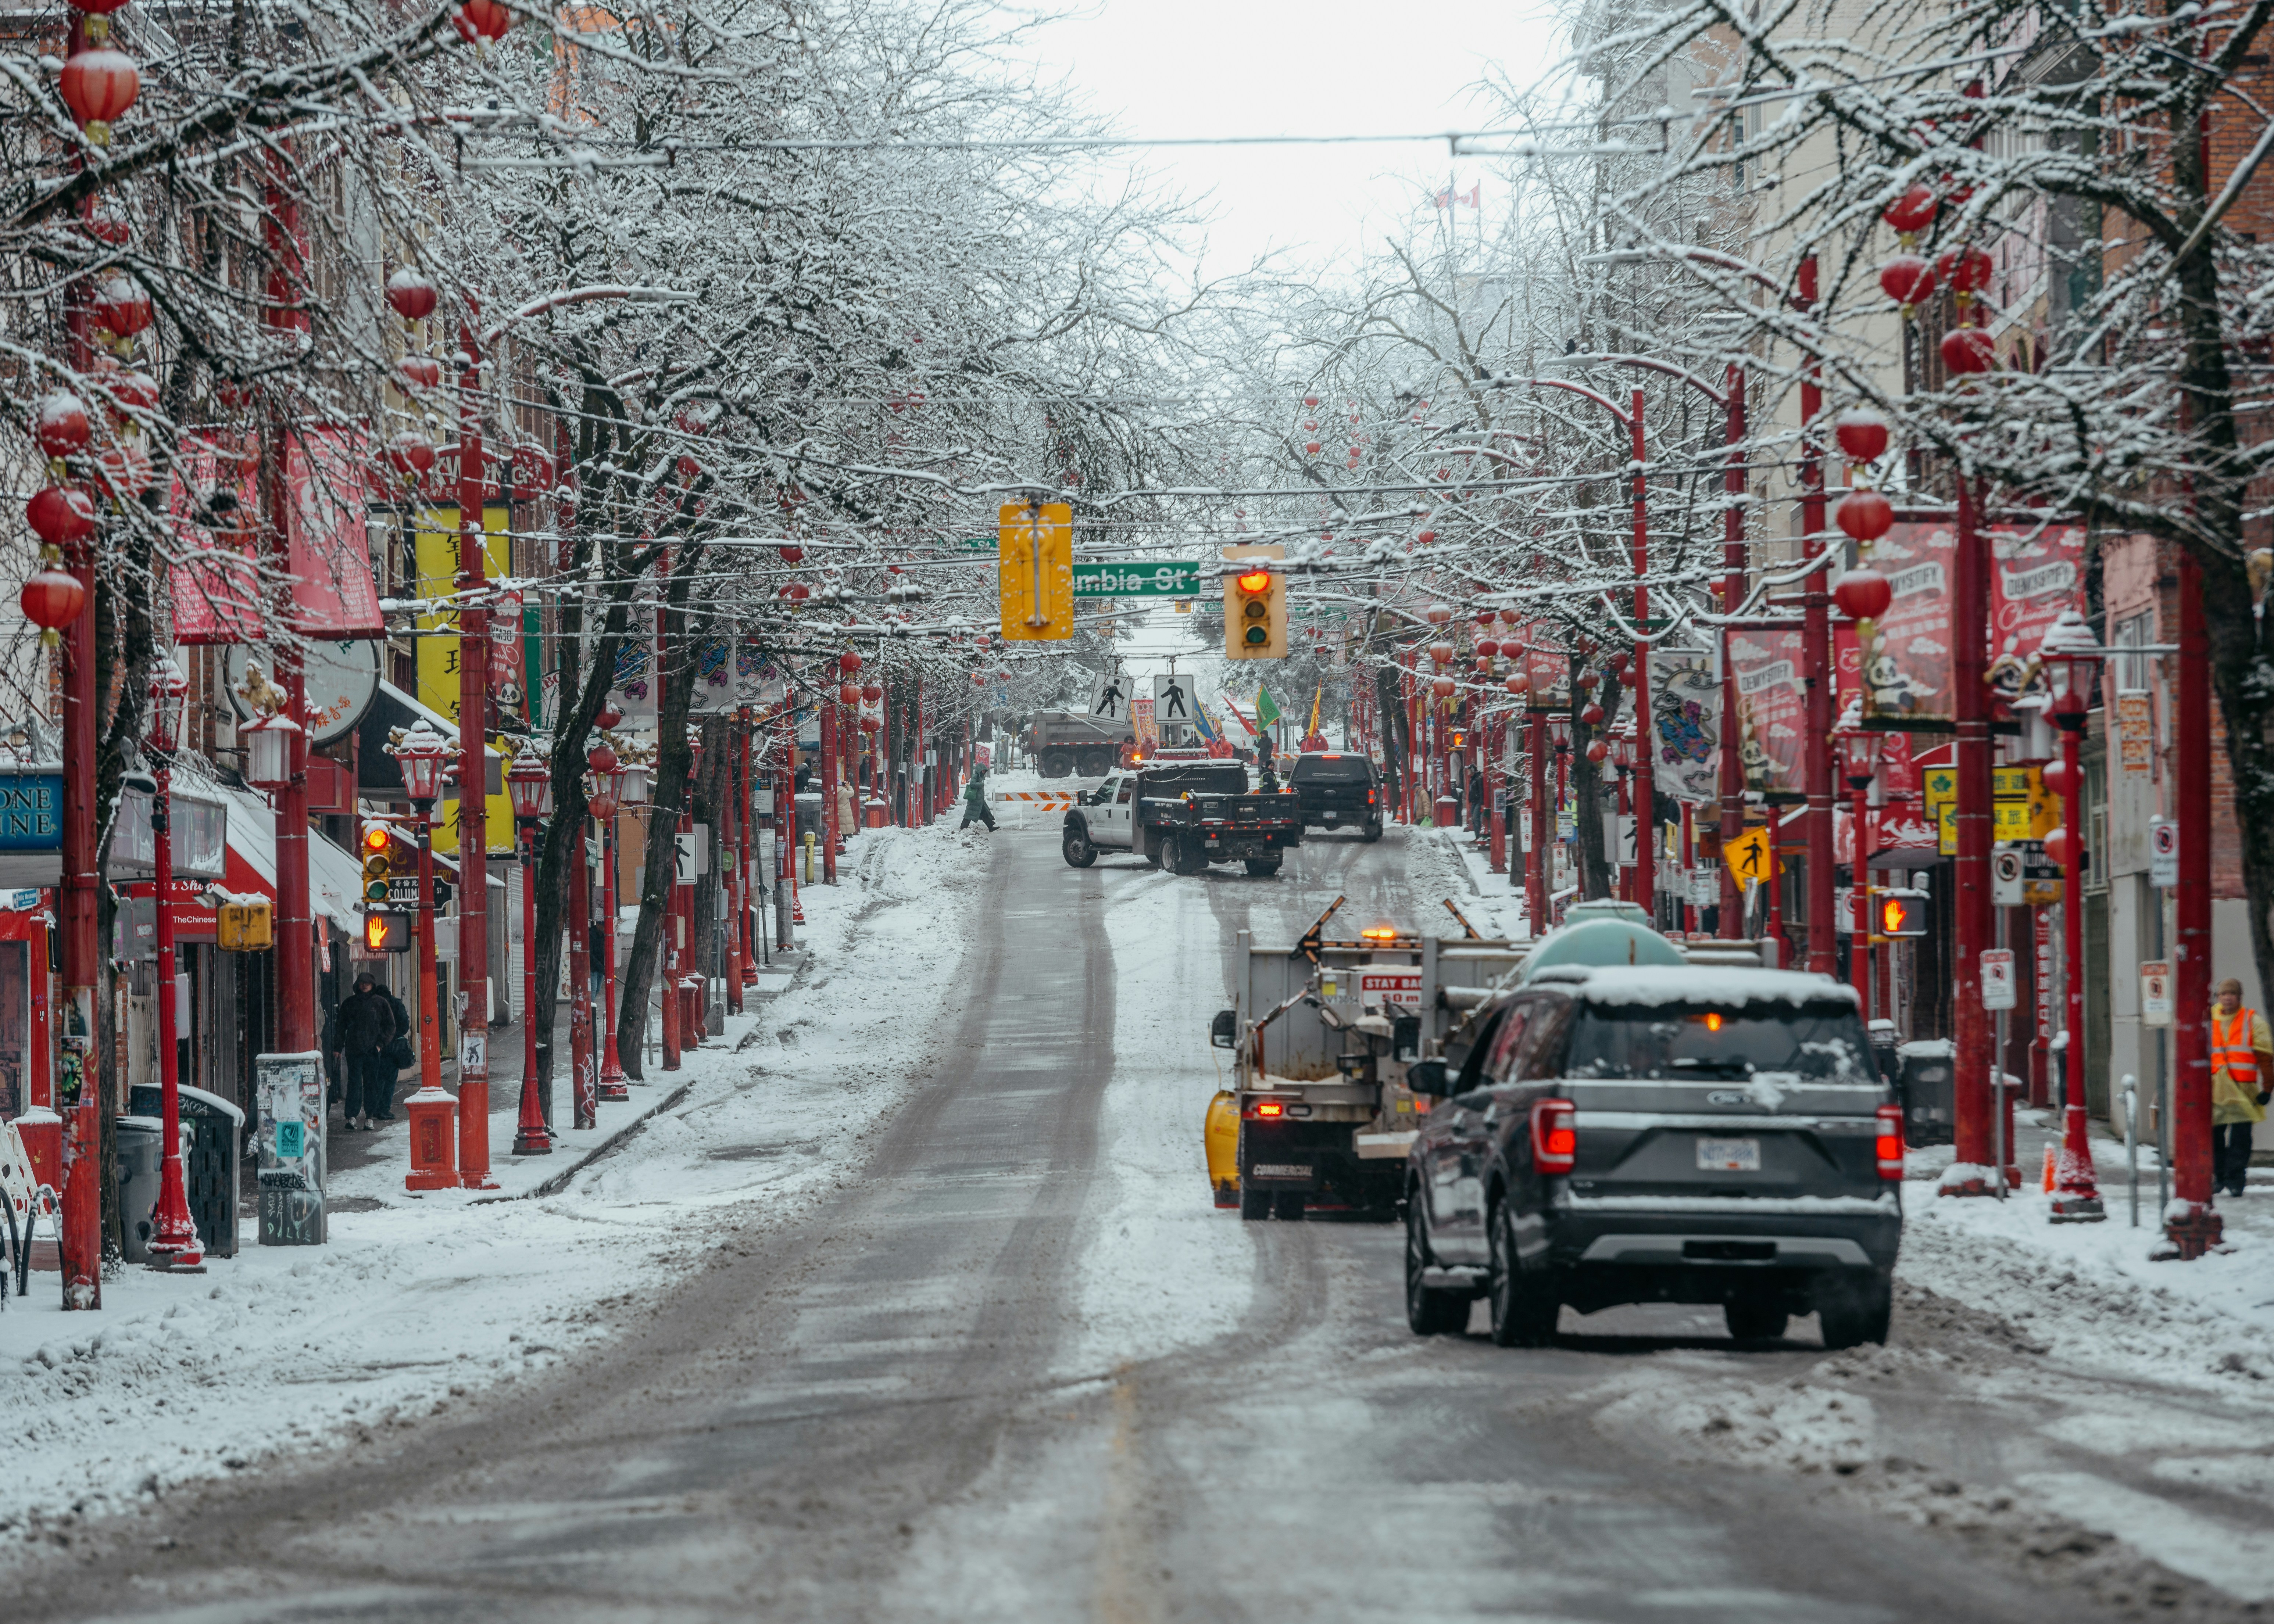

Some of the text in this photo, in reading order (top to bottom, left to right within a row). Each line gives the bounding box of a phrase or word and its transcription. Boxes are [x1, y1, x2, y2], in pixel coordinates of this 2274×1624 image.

[429, 455, 528, 486] KWNG
[1155, 567, 1184, 590] St
[388, 888, 419, 899] COLUM
[1365, 978, 1397, 988] STAY
[1252, 1164, 1313, 1177] COMMERCIAL
